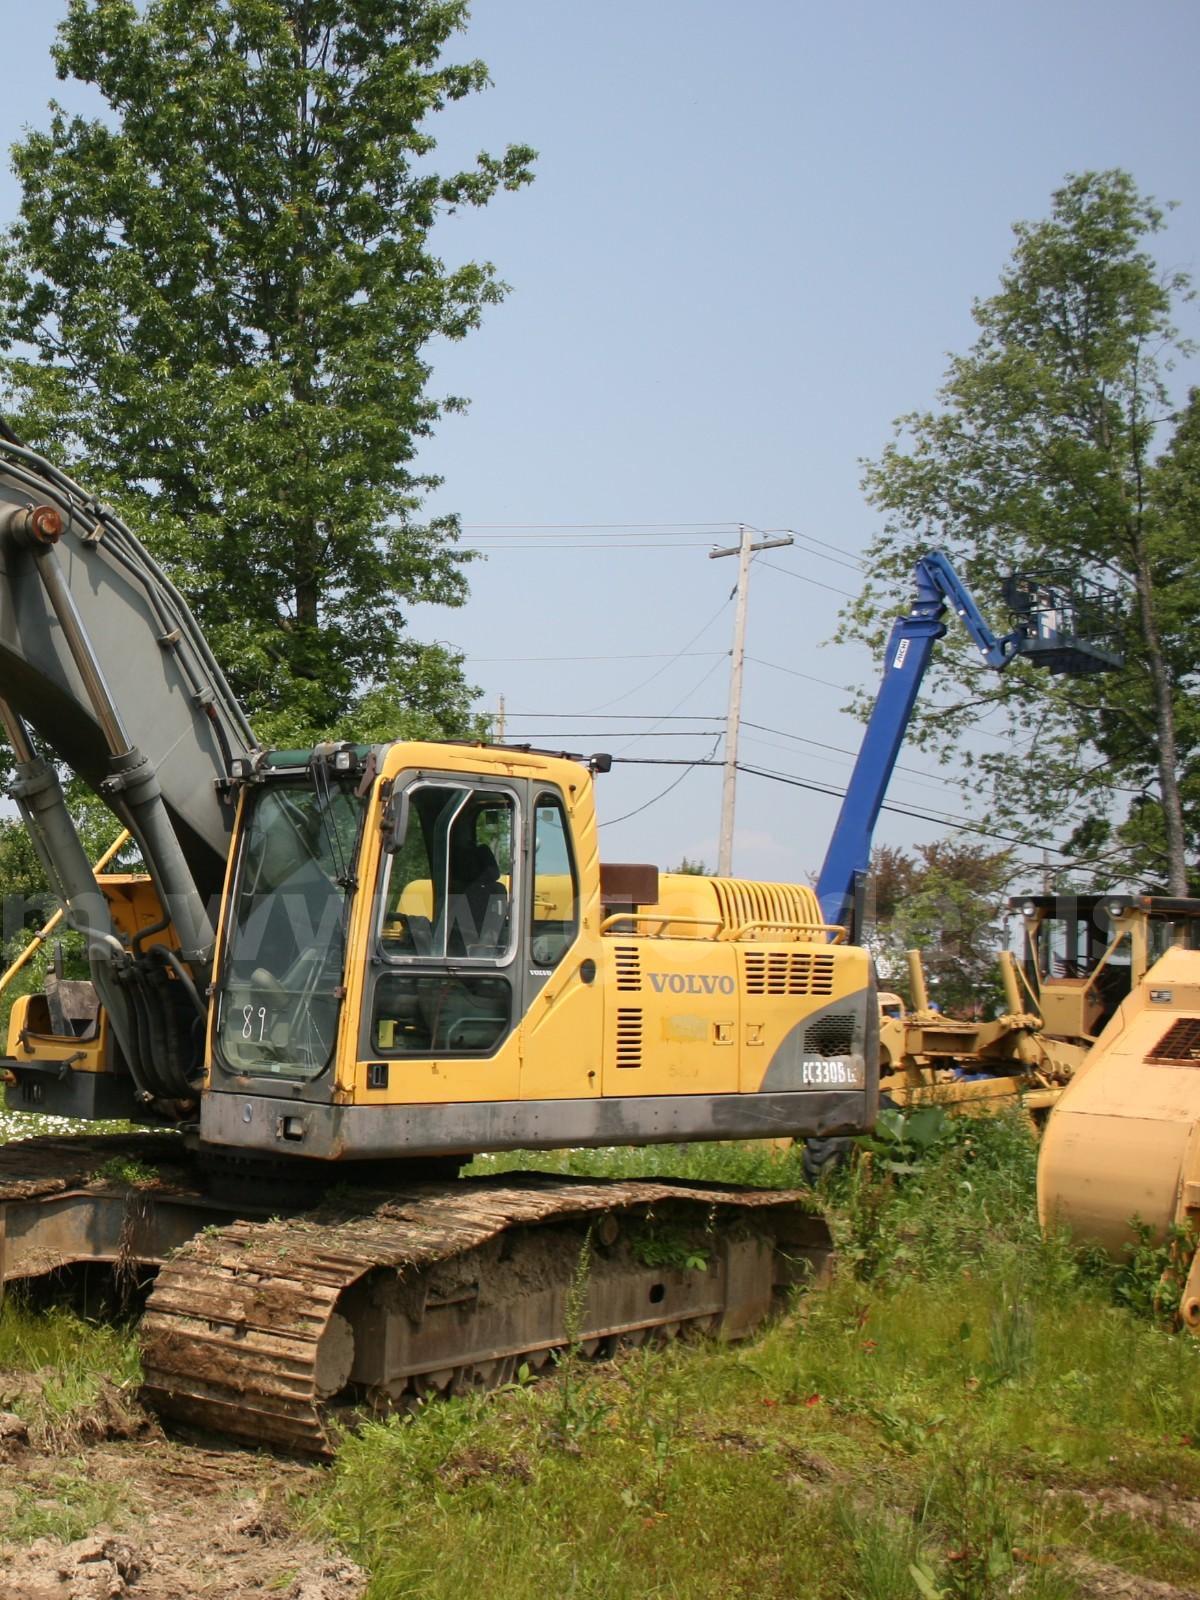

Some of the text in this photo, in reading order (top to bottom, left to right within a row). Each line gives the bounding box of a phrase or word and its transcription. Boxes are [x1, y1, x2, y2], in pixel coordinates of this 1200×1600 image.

[647, 973, 735, 995] VOLVO
[242, 1004, 266, 1041] 89
[803, 1061, 846, 1083] EC330B
